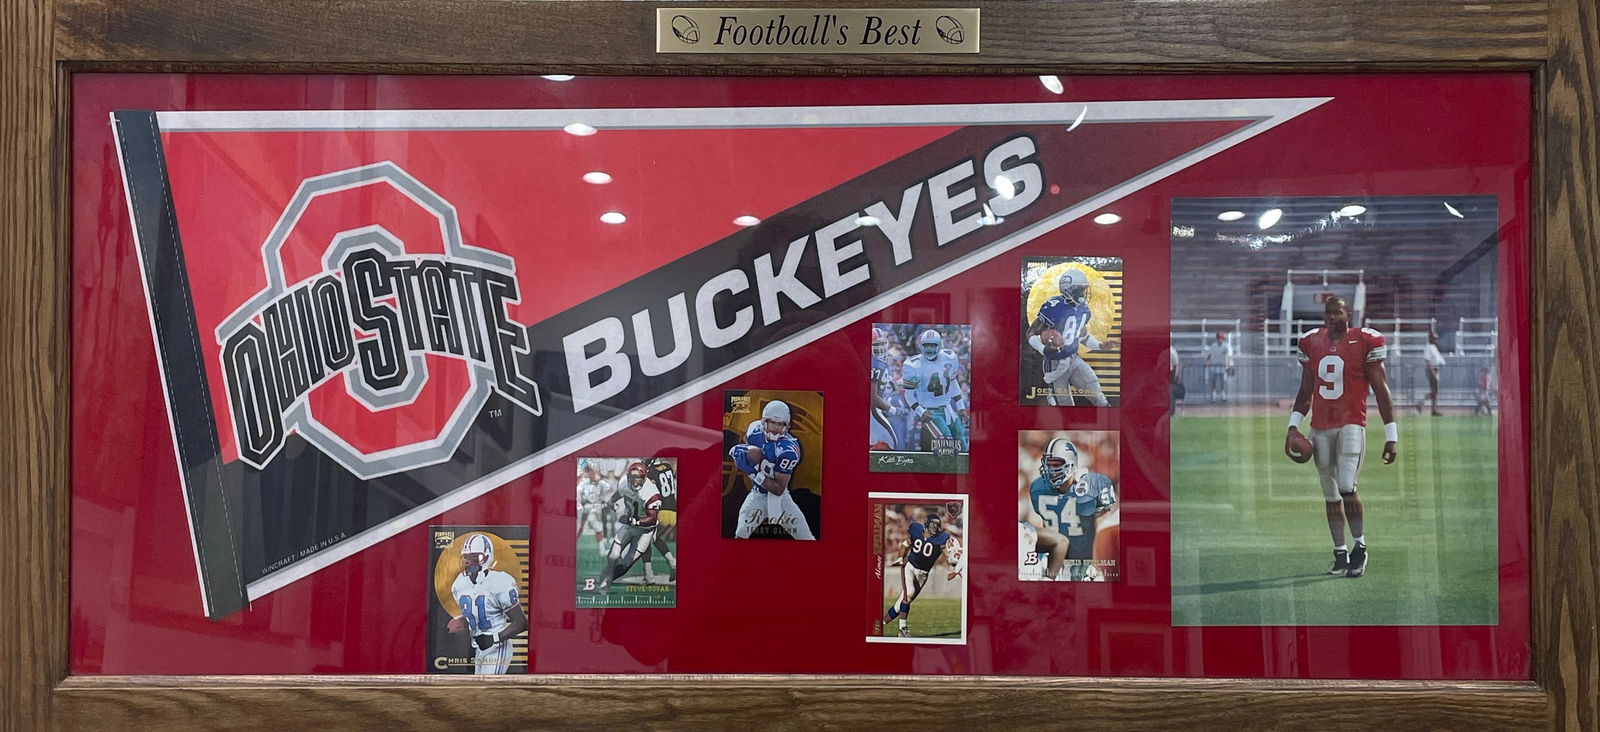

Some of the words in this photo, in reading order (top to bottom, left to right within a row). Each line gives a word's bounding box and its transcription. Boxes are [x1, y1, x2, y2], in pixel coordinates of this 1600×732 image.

[714, 15, 849, 46] Football's
[859, 15, 922, 46] Best
[562, 135, 1044, 414] BUCKEYES
[219, 273, 356, 469] OHIO
[342, 248, 542, 417] STATE
[1318, 355, 1345, 400] 9
[488, 408, 503, 418] TM
[659, 469, 675, 497] 87
[745, 508, 798, 525] Rookie
[1038, 495, 1084, 536] 54
[261, 554, 296, 575] WINCRAFT
[299, 543, 320, 558] MADE
[320, 540, 328, 549] IN
[912, 538, 934, 557] 90
[1025, 552, 1038, 565] B
[583, 578, 596, 591] B
[459, 595, 492, 630] 81
